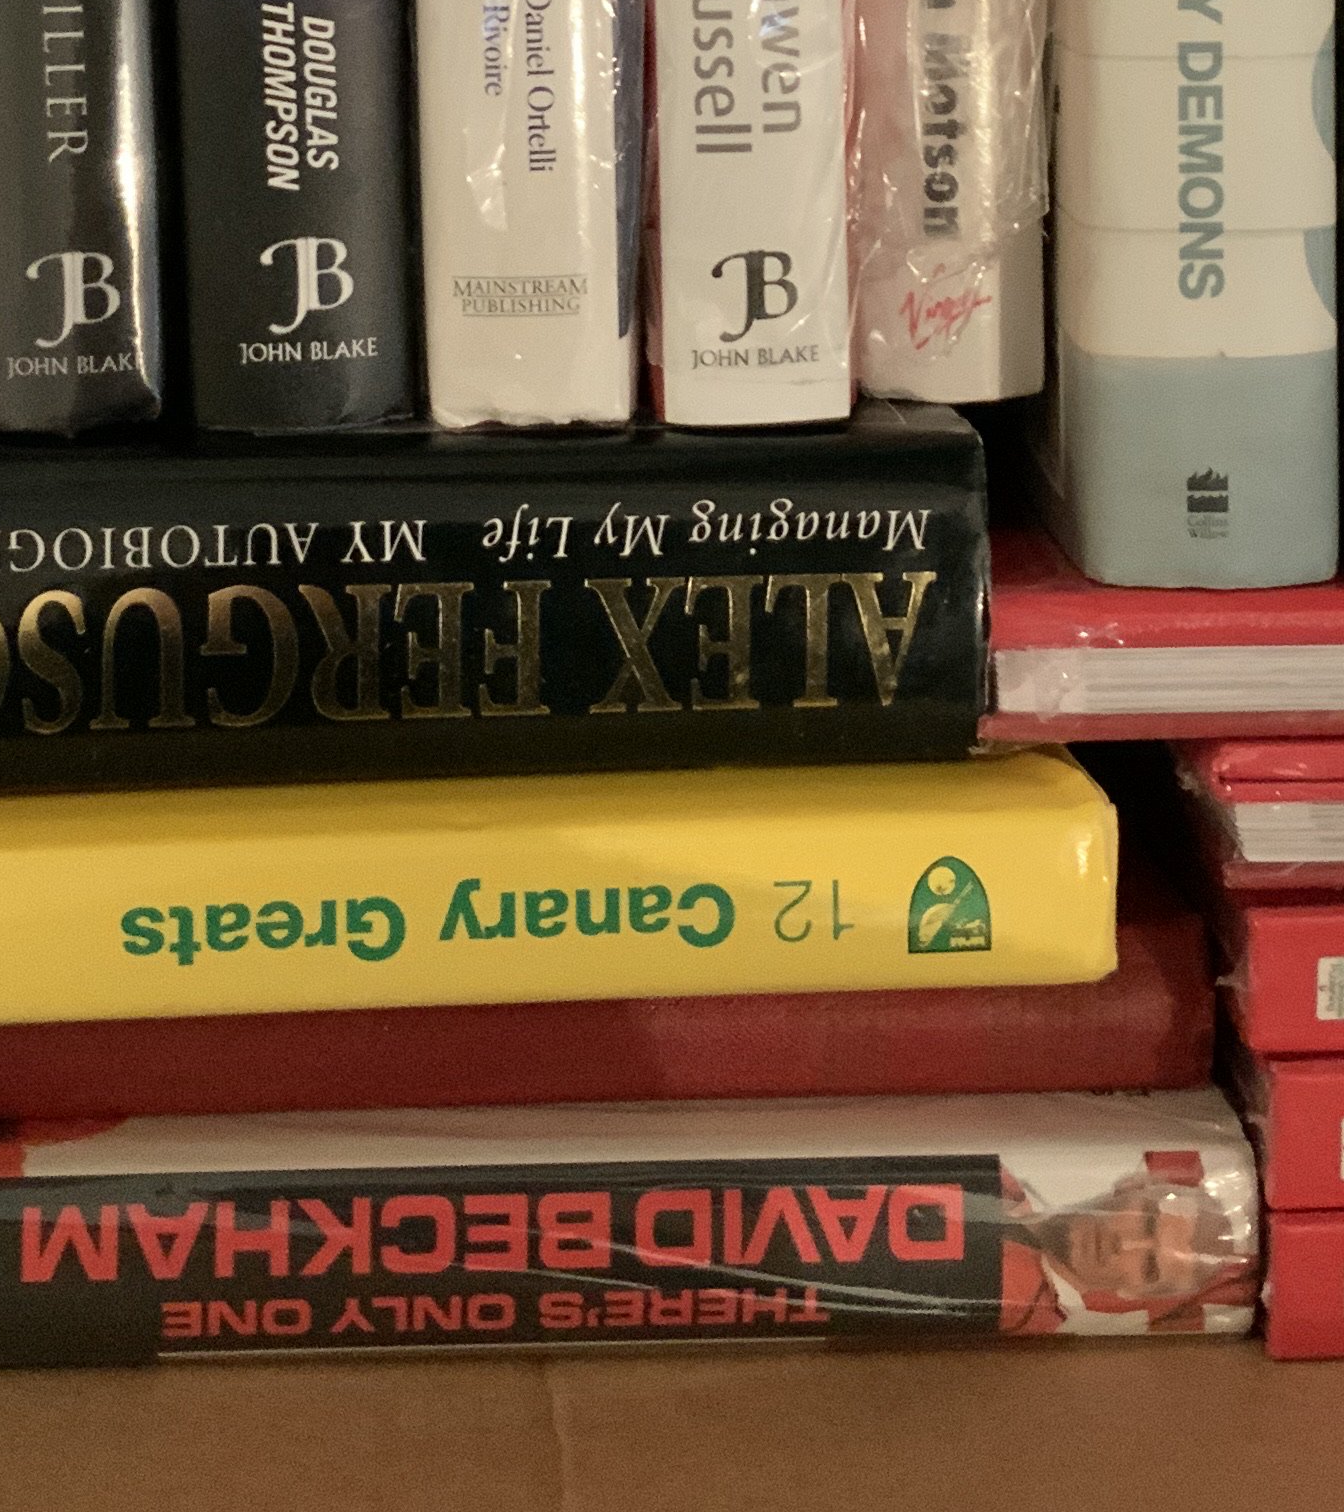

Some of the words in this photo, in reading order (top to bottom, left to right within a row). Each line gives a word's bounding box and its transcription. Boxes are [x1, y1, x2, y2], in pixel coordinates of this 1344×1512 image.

[483, 4, 511, 97] Rivoire
[261, 2, 300, 191] THOMPSON
[302, 16, 339, 170] DOUGLAS
[527, 86, 557, 172] Ortelli
[921, 32, 969, 238] Motson
[1176, 41, 1226, 301] DEMONS
[453, 278, 588, 297] MAINSTREAM
[461, 297, 580, 314] PUBLISHING
[7, 355, 68, 378] JOHN
[240, 341, 301, 364] JOHN
[311, 337, 378, 361] BLAKE
[692, 348, 750, 369] JOHN
[757, 345, 819, 367] BLAKE
[340, 518, 426, 562] MY
[482, 504, 573, 562] Life
[593, 502, 670, 556] My
[688, 498, 931, 553] Managing
[584, 570, 937, 713] ALEX
[121, 896, 407, 965] Greats
[440, 879, 736, 947] Canary
[773, 880, 854, 942] 12
[19, 1190, 615, 1282] BECKHAM
[635, 1182, 965, 1265] DAVID
[160, 1296, 312, 1337] ONE
[348, 1292, 517, 1337] ONLY
[539, 1284, 833, 1330] THERE'S
